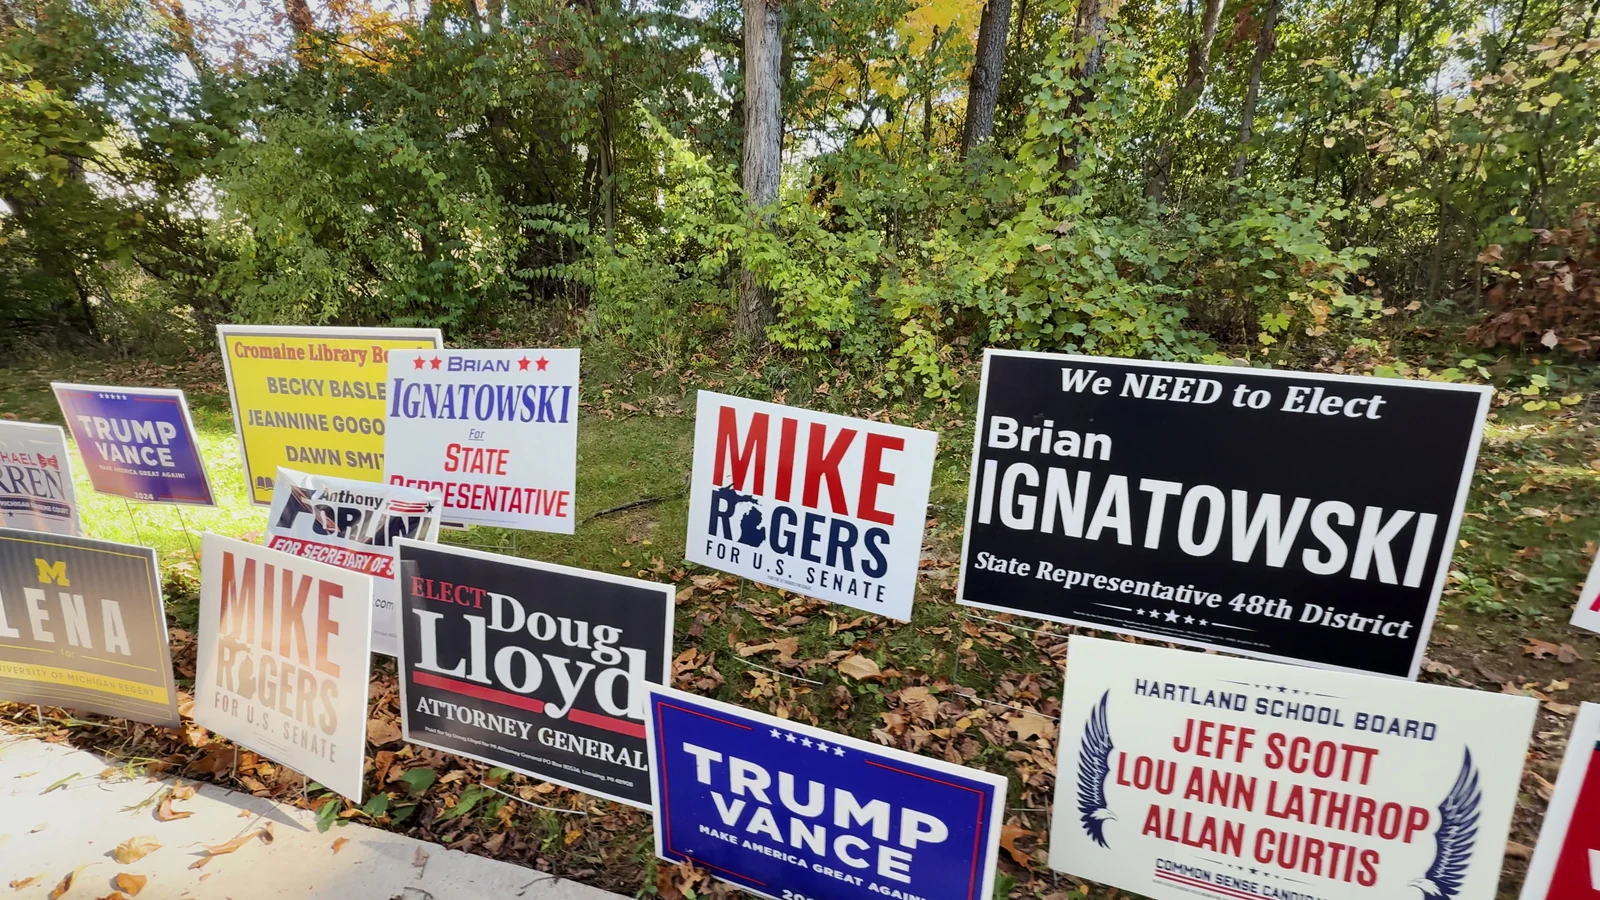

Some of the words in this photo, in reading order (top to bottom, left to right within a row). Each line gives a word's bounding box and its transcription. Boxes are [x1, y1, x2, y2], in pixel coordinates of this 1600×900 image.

[234, 341, 305, 360] Cromaine
[308, 343, 368, 368] Library
[447, 356, 510, 373] BRIAN
[267, 376, 324, 398] BECKY
[329, 380, 387, 400] BASLE
[390, 378, 572, 424] IGNATOWSKI
[1059, 367, 1112, 395] We
[1119, 371, 1224, 406] NEED
[1231, 383, 1272, 410] to
[1280, 386, 1387, 421] Elect
[77, 415, 177, 445] TRUMP
[248, 409, 329, 432] JEANNINE
[332, 415, 385, 436] GOGO
[468, 428, 485, 440] For
[986, 416, 1113, 461] Brian
[0, 451, 37, 466] HAEL
[94, 442, 175, 468] VANCE
[114, 466, 138, 476] AMERICA
[161, 471, 186, 479] AGAIN!
[285, 445, 342, 466] DAWN
[444, 443, 510, 476] STATE
[712, 405, 905, 526] MIKE
[134, 492, 154, 500] 2024
[318, 488, 384, 509] Anthony
[976, 459, 1439, 589] IGNATOWSKI
[34, 558, 70, 586] M
[273, 538, 302, 555] FOR
[301, 543, 373, 570] SECRETARY
[372, 558, 388, 573] OF
[705, 539, 740, 564] FOR
[752, 554, 792, 579] U.S.
[806, 566, 886, 603] SENATE
[410, 575, 487, 609] ELECT
[974, 550, 1031, 578] State
[1034, 561, 1223, 609] Representative
[1227, 591, 1293, 620] 48th
[1299, 603, 1413, 641] District
[220, 551, 344, 679] MIKE
[486, 591, 623, 666] Doug
[51, 671, 64, 680] OF
[67, 673, 116, 689] MICHIGAN
[118, 683, 154, 697] REGENT
[411, 607, 647, 720] Lloyd
[214, 691, 238, 719] FOR
[246, 703, 275, 733] U.S.
[283, 722, 337, 764] SENATE
[1135, 678, 1248, 712] HARTLAND
[1254, 697, 1345, 728] SCHOOL
[1354, 712, 1437, 742] BOARD
[415, 696, 533, 741] ATTORNEY
[537, 727, 649, 772] GENERAL
[1173, 718, 1256, 764] JEFF
[1265, 732, 1379, 787] SCOTT
[683, 741, 949, 850] TRUMP
[1116, 751, 1177, 795] LOU
[1184, 766, 1258, 813] ANN
[1265, 780, 1430, 844] LATHROP
[699, 823, 738, 845] MAKE
[741, 839, 809, 869] AMERICA
[812, 863, 864, 887] GREAT
[710, 791, 913, 884] VANCE
[1142, 804, 1245, 858] ALLAN
[1254, 828, 1380, 888] CURTIS
[1155, 857, 1212, 882] COMMON
[1215, 873, 1259, 894] SENSE
